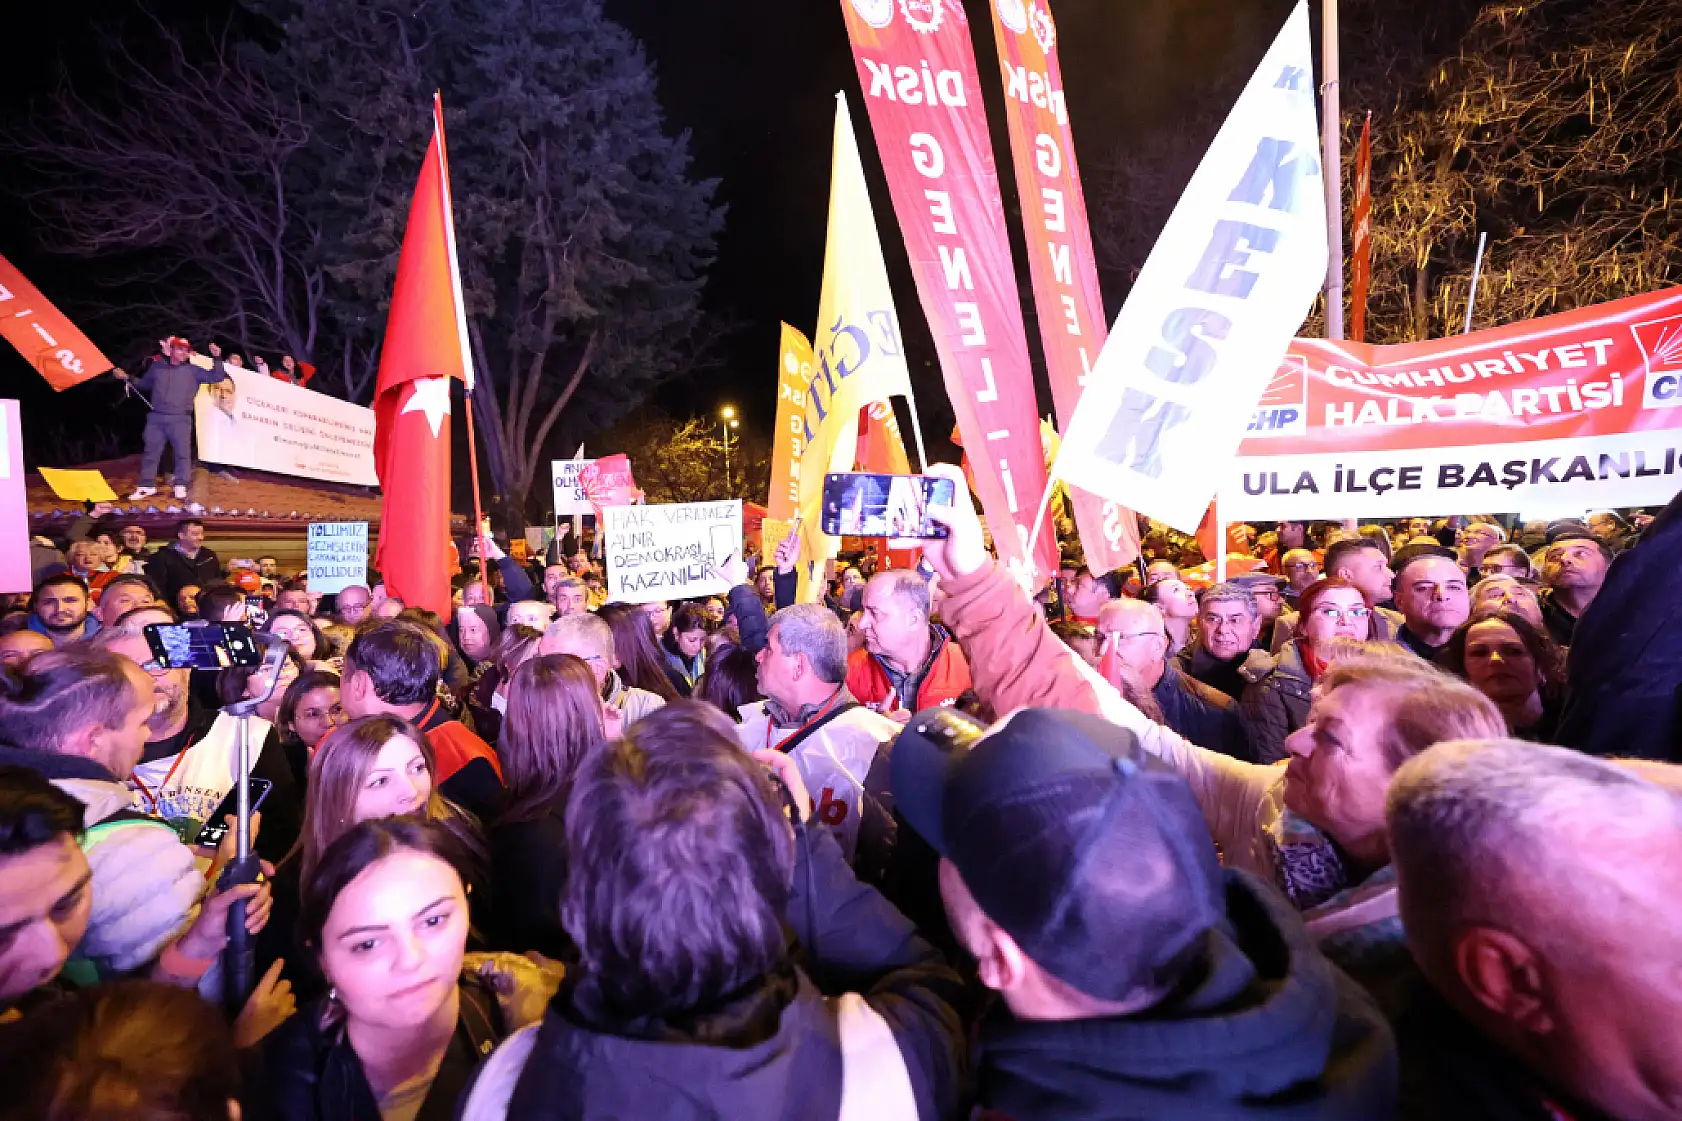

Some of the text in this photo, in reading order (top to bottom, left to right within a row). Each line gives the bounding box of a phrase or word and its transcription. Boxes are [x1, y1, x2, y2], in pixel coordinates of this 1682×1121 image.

[1093, 136, 1319, 479] KESK
[1325, 337, 1614, 389] CUMHURİYET
[1652, 373, 1682, 400] C
[1247, 409, 1299, 431] HP
[1325, 372, 1623, 428] HALK PARTİSİ
[1243, 447, 1682, 496] ULA İLÇE BAŞKANLI
[613, 508, 655, 530] HAK
